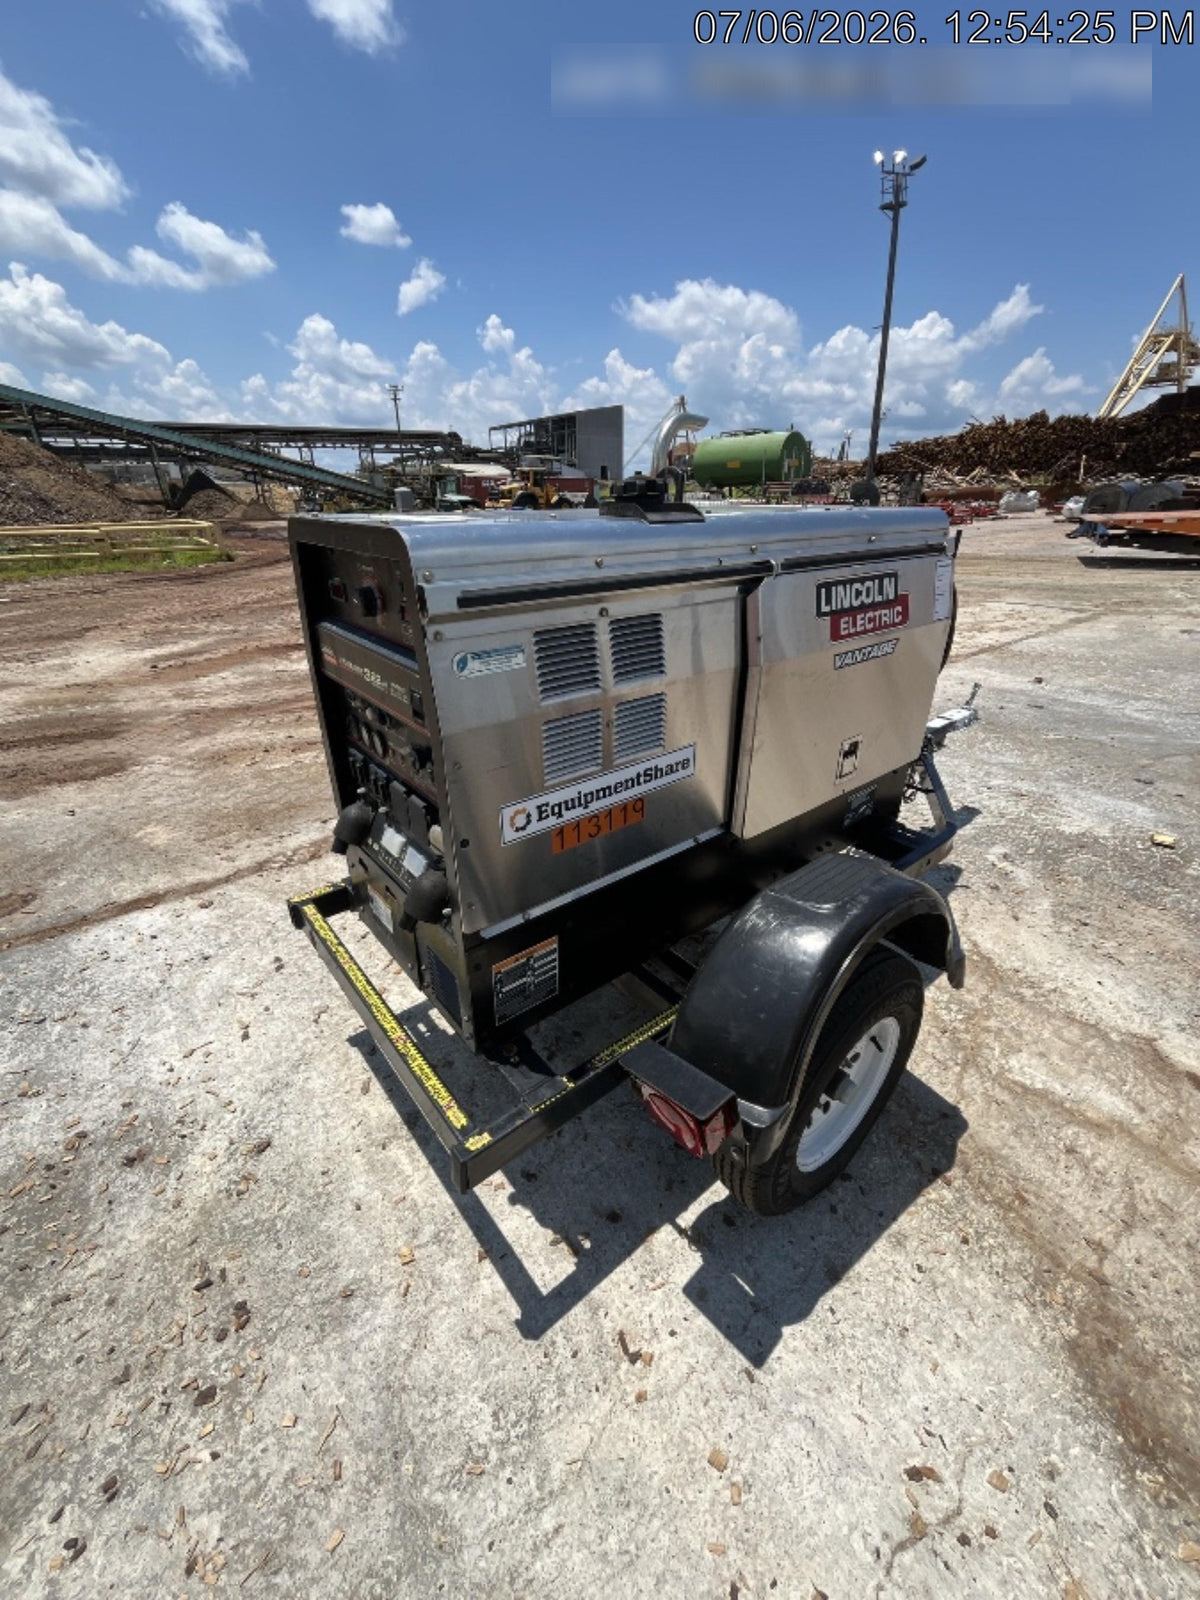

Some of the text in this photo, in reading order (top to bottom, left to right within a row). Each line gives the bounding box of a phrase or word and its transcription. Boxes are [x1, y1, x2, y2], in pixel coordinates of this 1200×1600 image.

[821, 577, 896, 612] LINCOLN
[840, 605, 903, 636] ELECTRIC
[834, 638, 899, 671] VANTAGE
[536, 757, 691, 824] EquipmentShare
[556, 797, 645, 850] 113119
